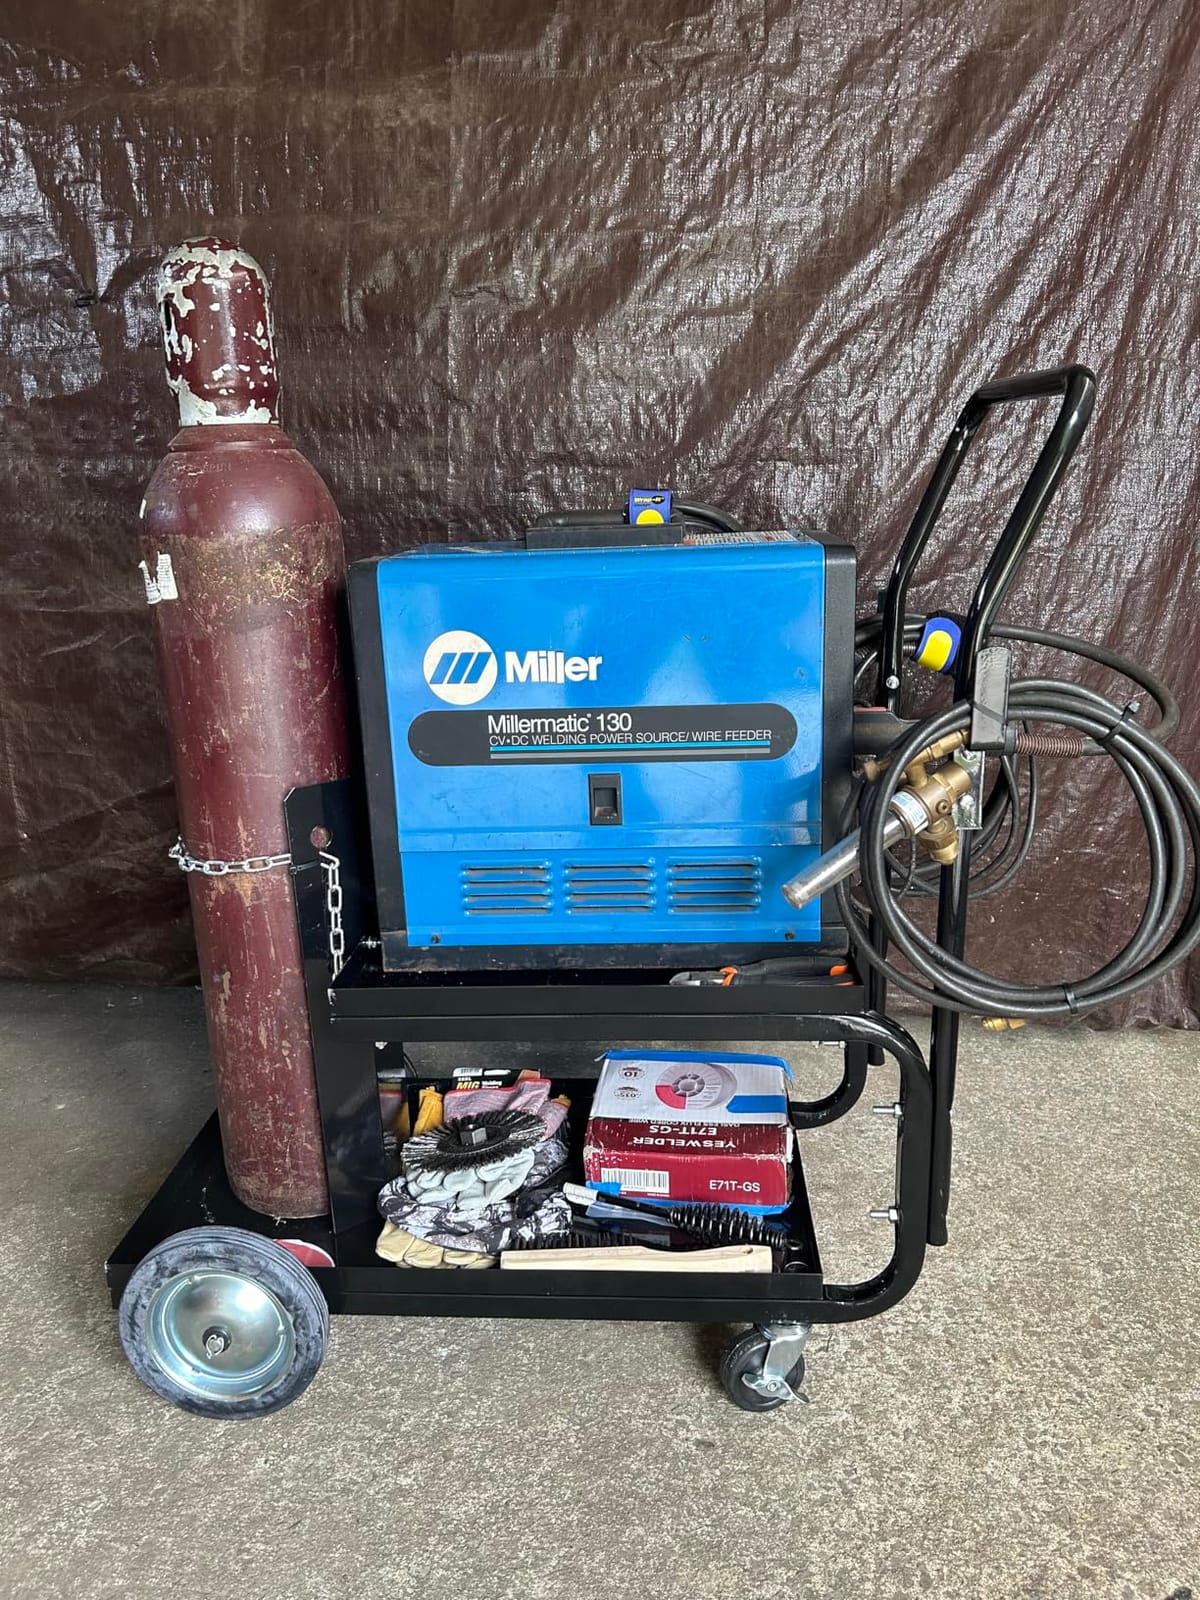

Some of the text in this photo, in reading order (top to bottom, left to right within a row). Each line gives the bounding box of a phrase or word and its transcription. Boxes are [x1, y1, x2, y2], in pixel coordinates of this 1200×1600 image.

[505, 650, 603, 684] Miller
[487, 713, 633, 734] Millermatic 130
[532, 734, 587, 745] WELDING
[590, 733, 633, 744] POWER
[636, 731, 689, 743] SOURCE/
[692, 730, 722, 742] WIRE
[725, 729, 772, 741] FEEDER
[456, 1081, 480, 1090] MIG
[649, 1125, 718, 1135] E71T-GS
[633, 1137, 737, 1148] YESWELDER
[709, 1179, 761, 1193] E71T-GS
